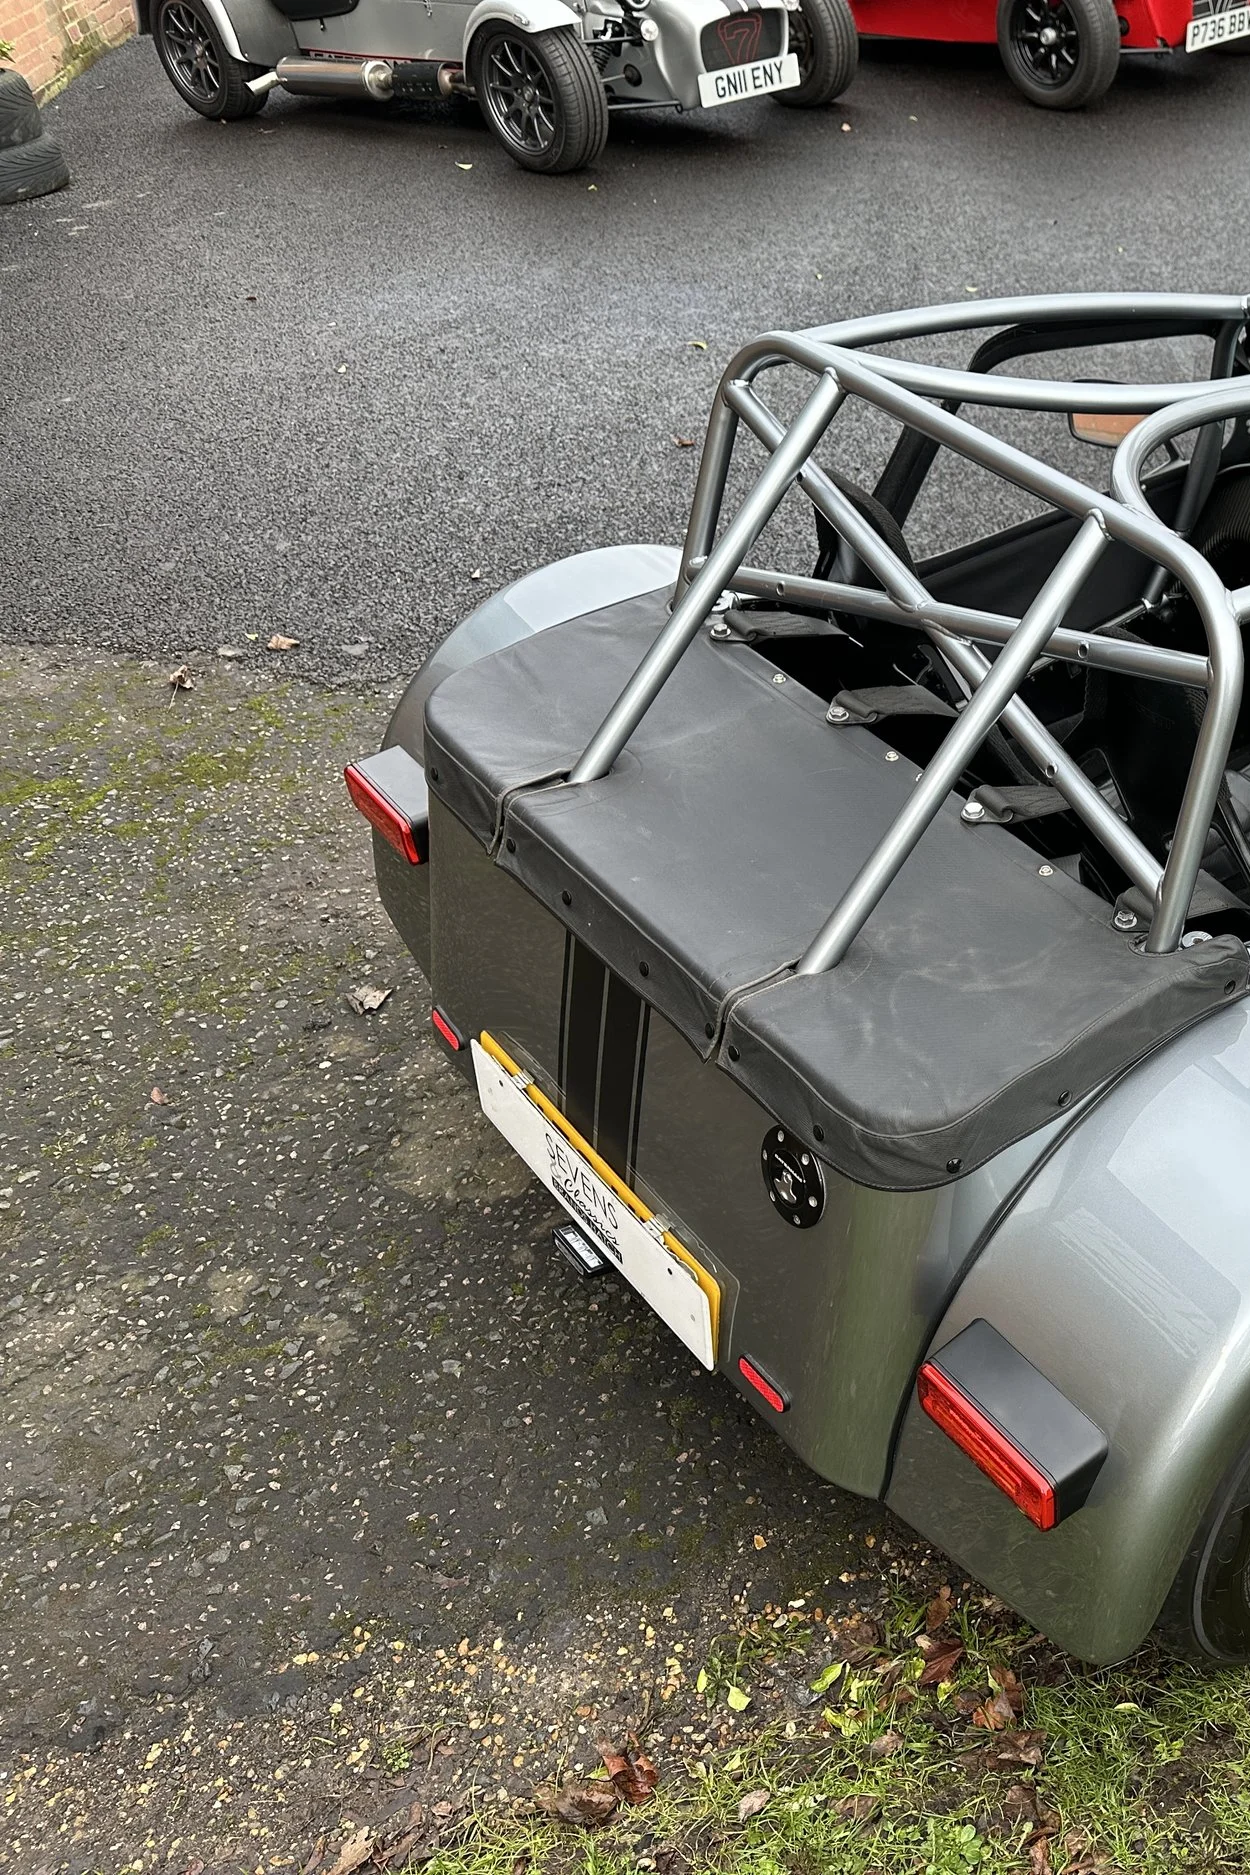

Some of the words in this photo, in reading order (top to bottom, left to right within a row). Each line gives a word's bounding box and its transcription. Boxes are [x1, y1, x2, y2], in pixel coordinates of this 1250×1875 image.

[1191, 18, 1225, 46] P736
[715, 69, 748, 98] GN11
[751, 60, 783, 89] ENY
[545, 1133, 619, 1230] SEVENS
[564, 1178, 620, 1247] Classics
